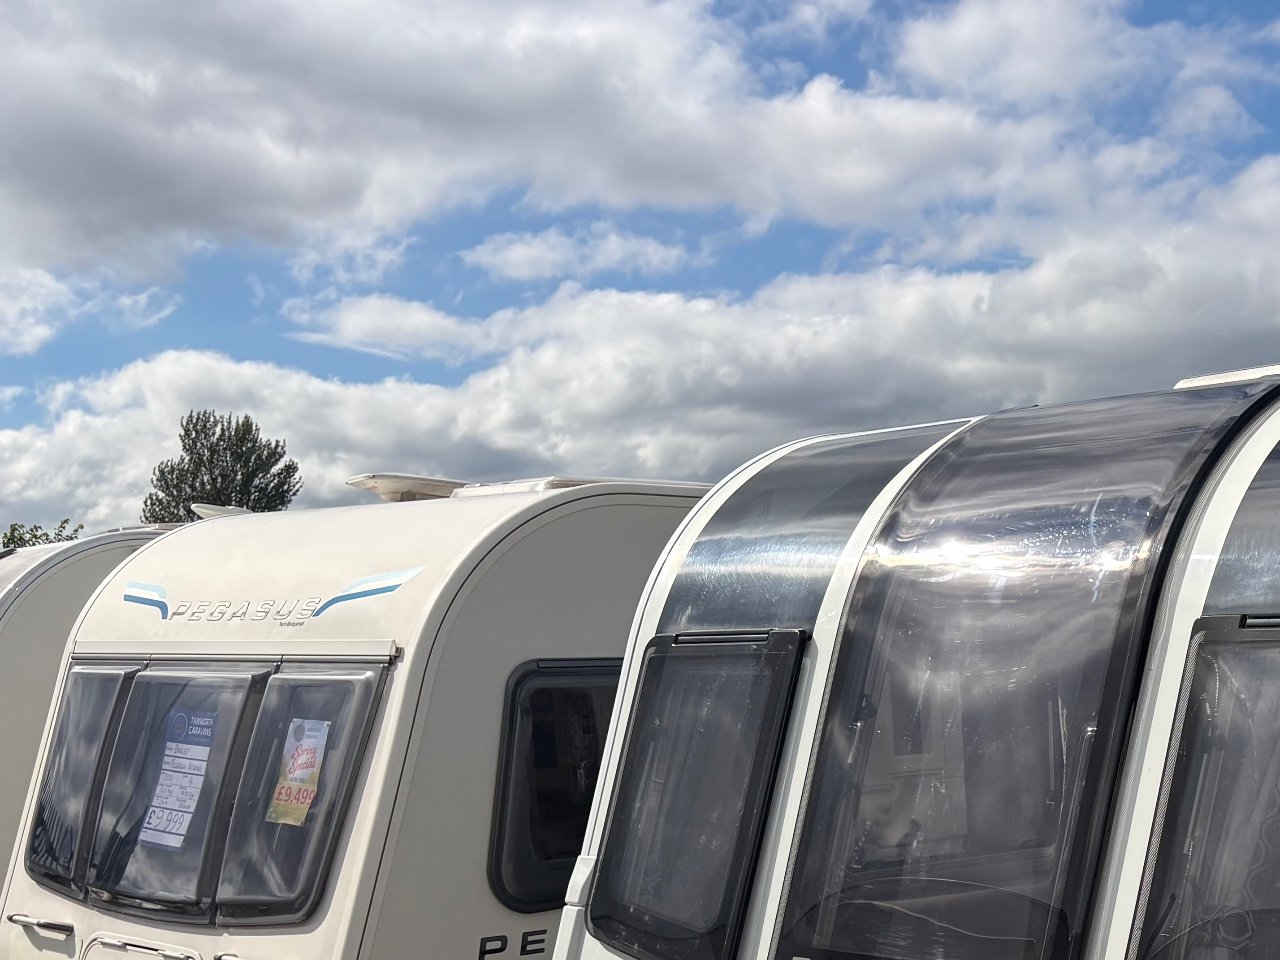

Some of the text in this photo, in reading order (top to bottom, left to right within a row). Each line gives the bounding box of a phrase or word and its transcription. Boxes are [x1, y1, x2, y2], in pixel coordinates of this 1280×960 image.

[168, 597, 322, 622] PEGASUS
[291, 743, 318, 760] Spring
[288, 755, 317, 775] Special
[275, 785, 316, 806] £9,499
